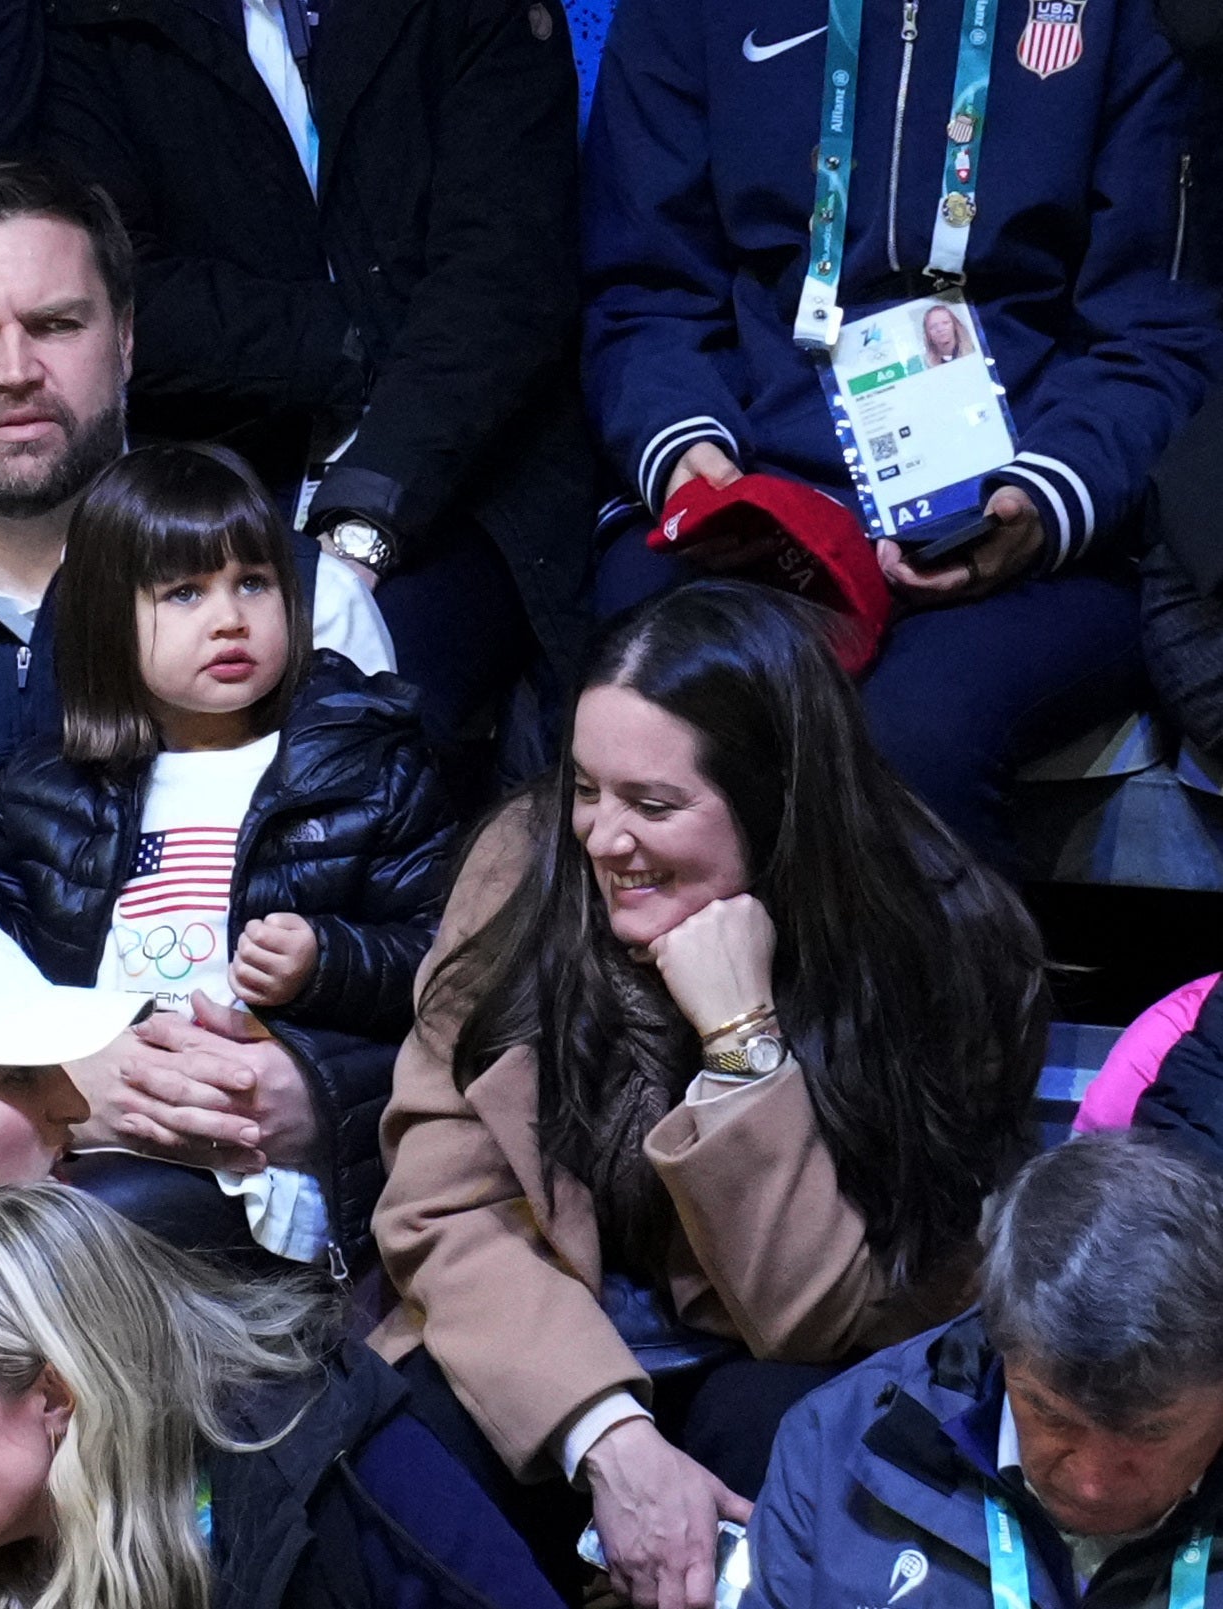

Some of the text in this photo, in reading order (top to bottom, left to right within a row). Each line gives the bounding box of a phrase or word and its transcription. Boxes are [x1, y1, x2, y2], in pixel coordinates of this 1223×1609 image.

[1037, 2, 1074, 14] USA
[830, 88, 846, 133] Allianz
[897, 499, 933, 526] A 2
[997, 1511, 1013, 1553] Allianz
